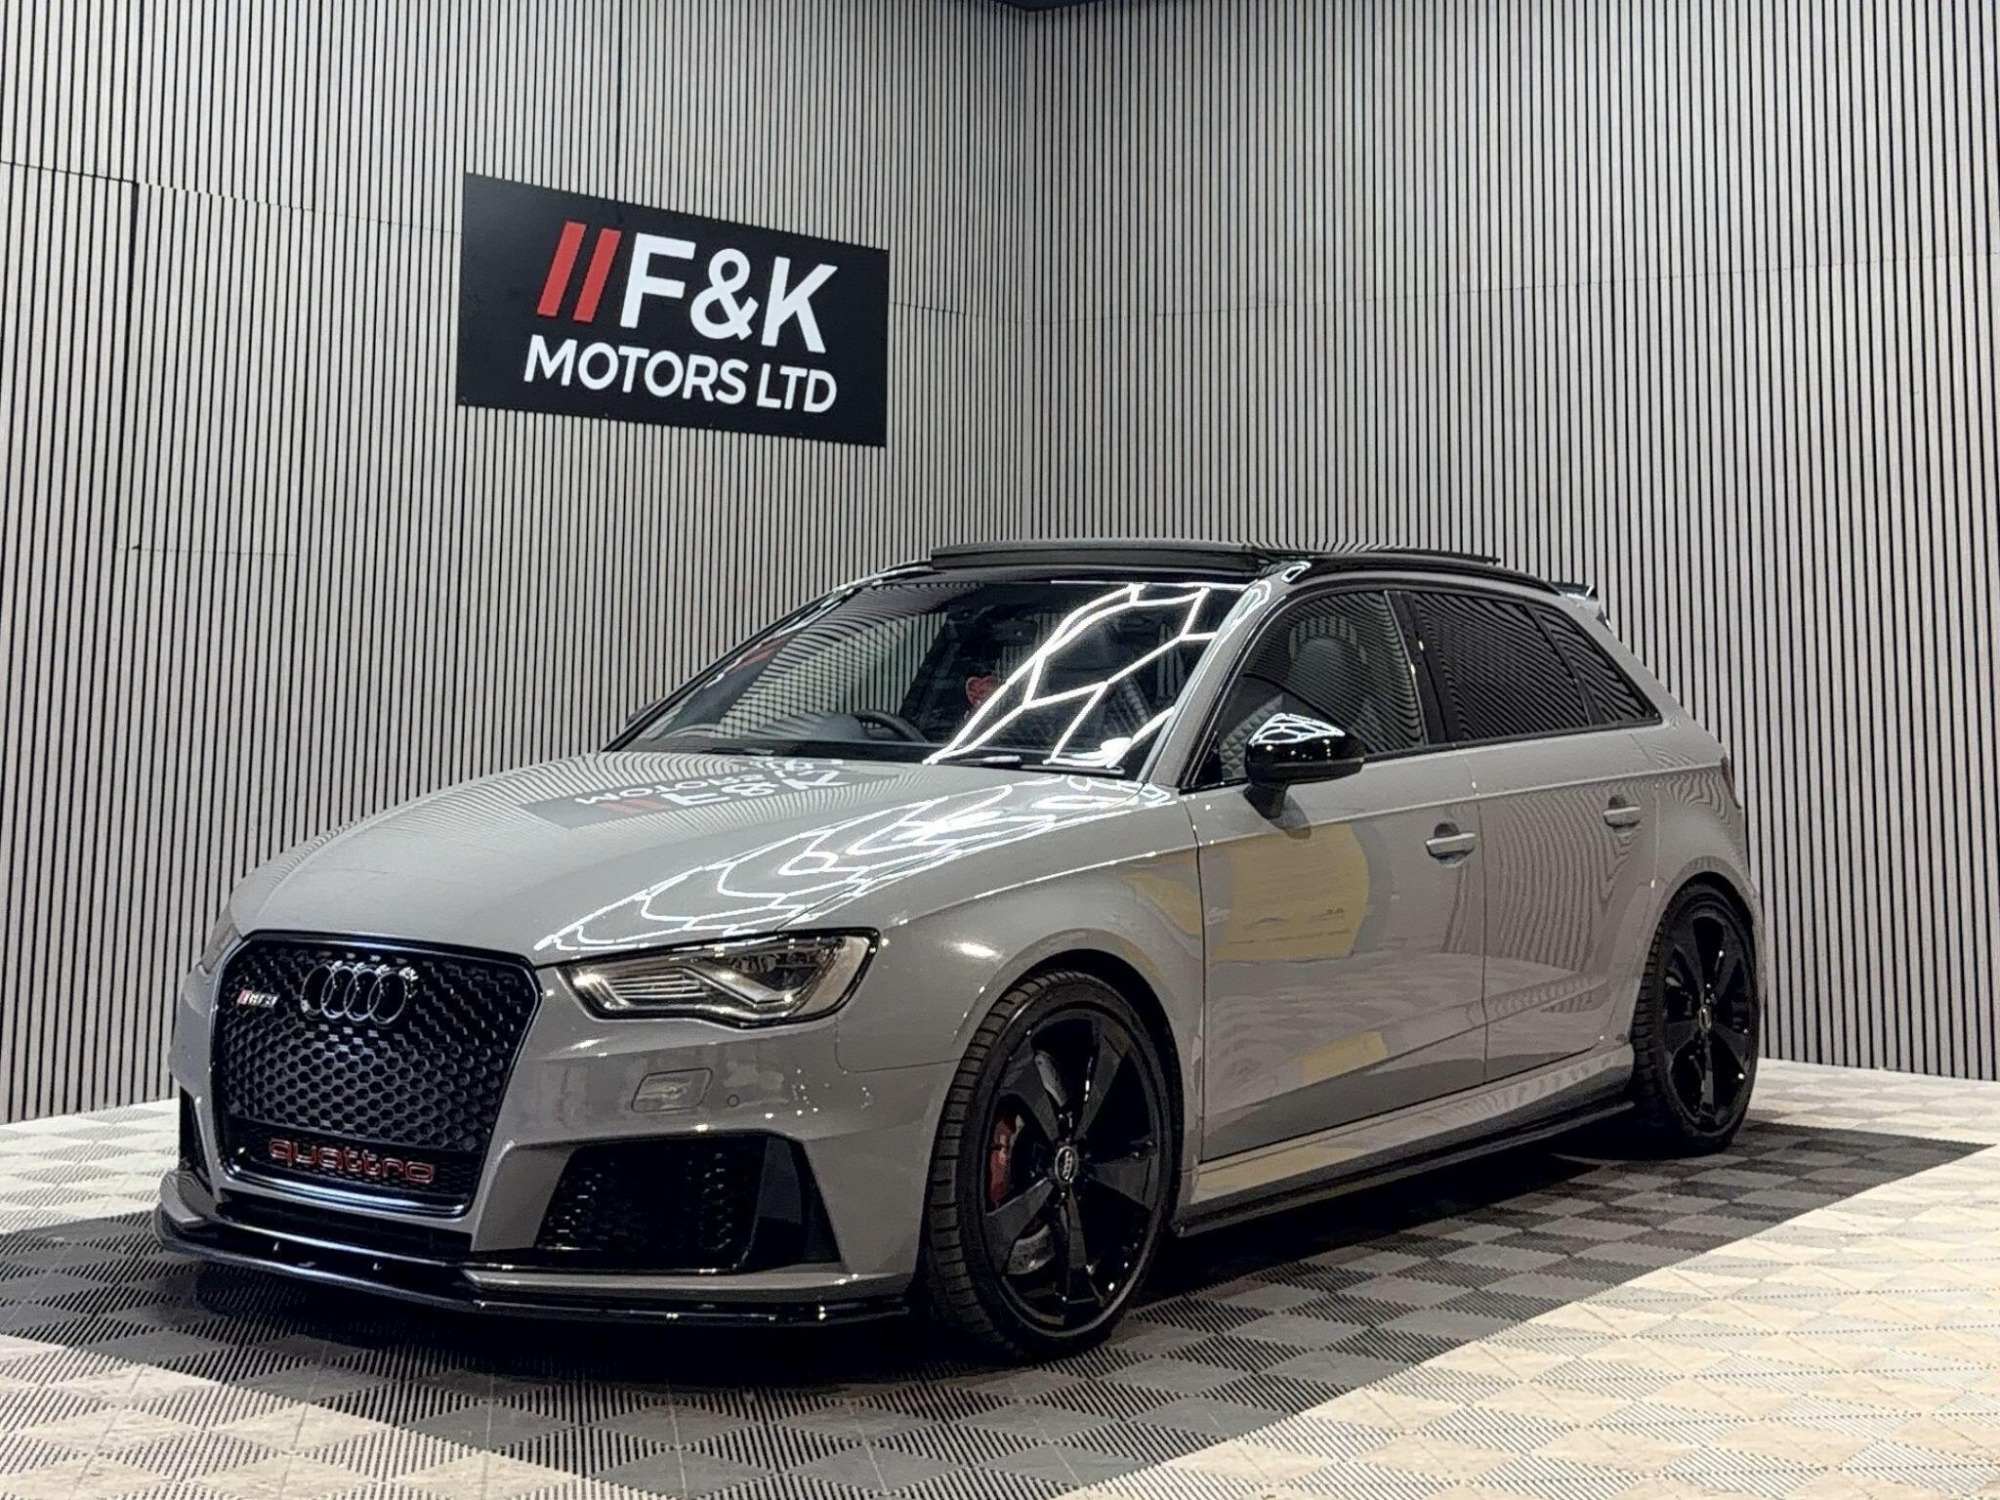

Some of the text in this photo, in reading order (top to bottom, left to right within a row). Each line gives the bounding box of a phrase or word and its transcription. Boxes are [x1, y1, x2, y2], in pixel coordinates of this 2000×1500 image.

[523, 334, 837, 414] MOTORS LTD
[269, 1138, 434, 1184] quattro
